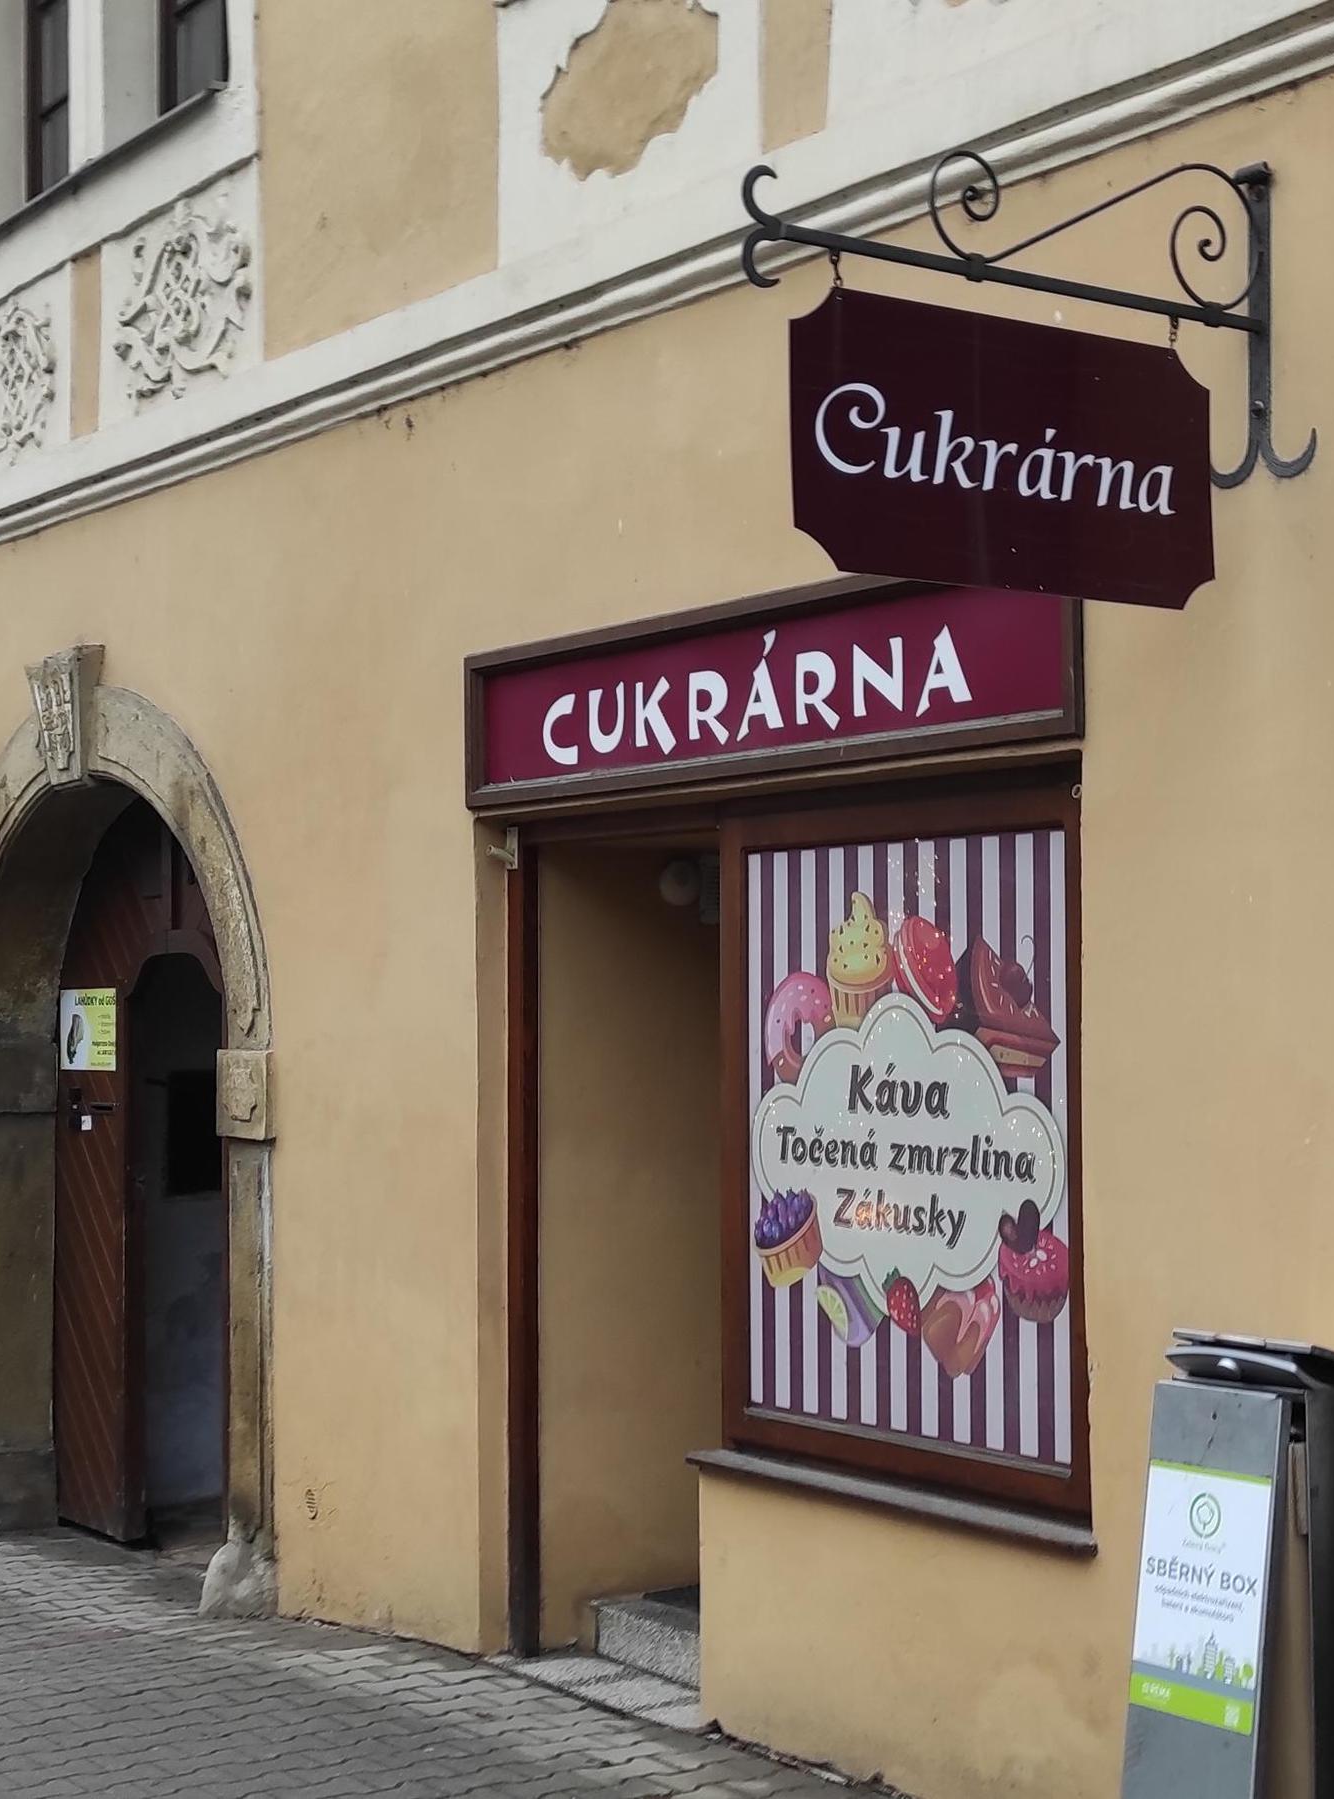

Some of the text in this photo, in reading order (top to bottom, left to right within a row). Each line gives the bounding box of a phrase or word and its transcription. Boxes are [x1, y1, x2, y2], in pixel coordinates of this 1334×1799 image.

[814, 382, 1177, 516] Cukrárna
[541, 624, 973, 766] CUKRÁRNA
[847, 1062, 951, 1119] Káva
[775, 1125, 1037, 1183] Točená zmrzlina
[832, 1187, 967, 1250] Zákusky
[1145, 1555, 1259, 1598] SBĚRNÝ BOX
